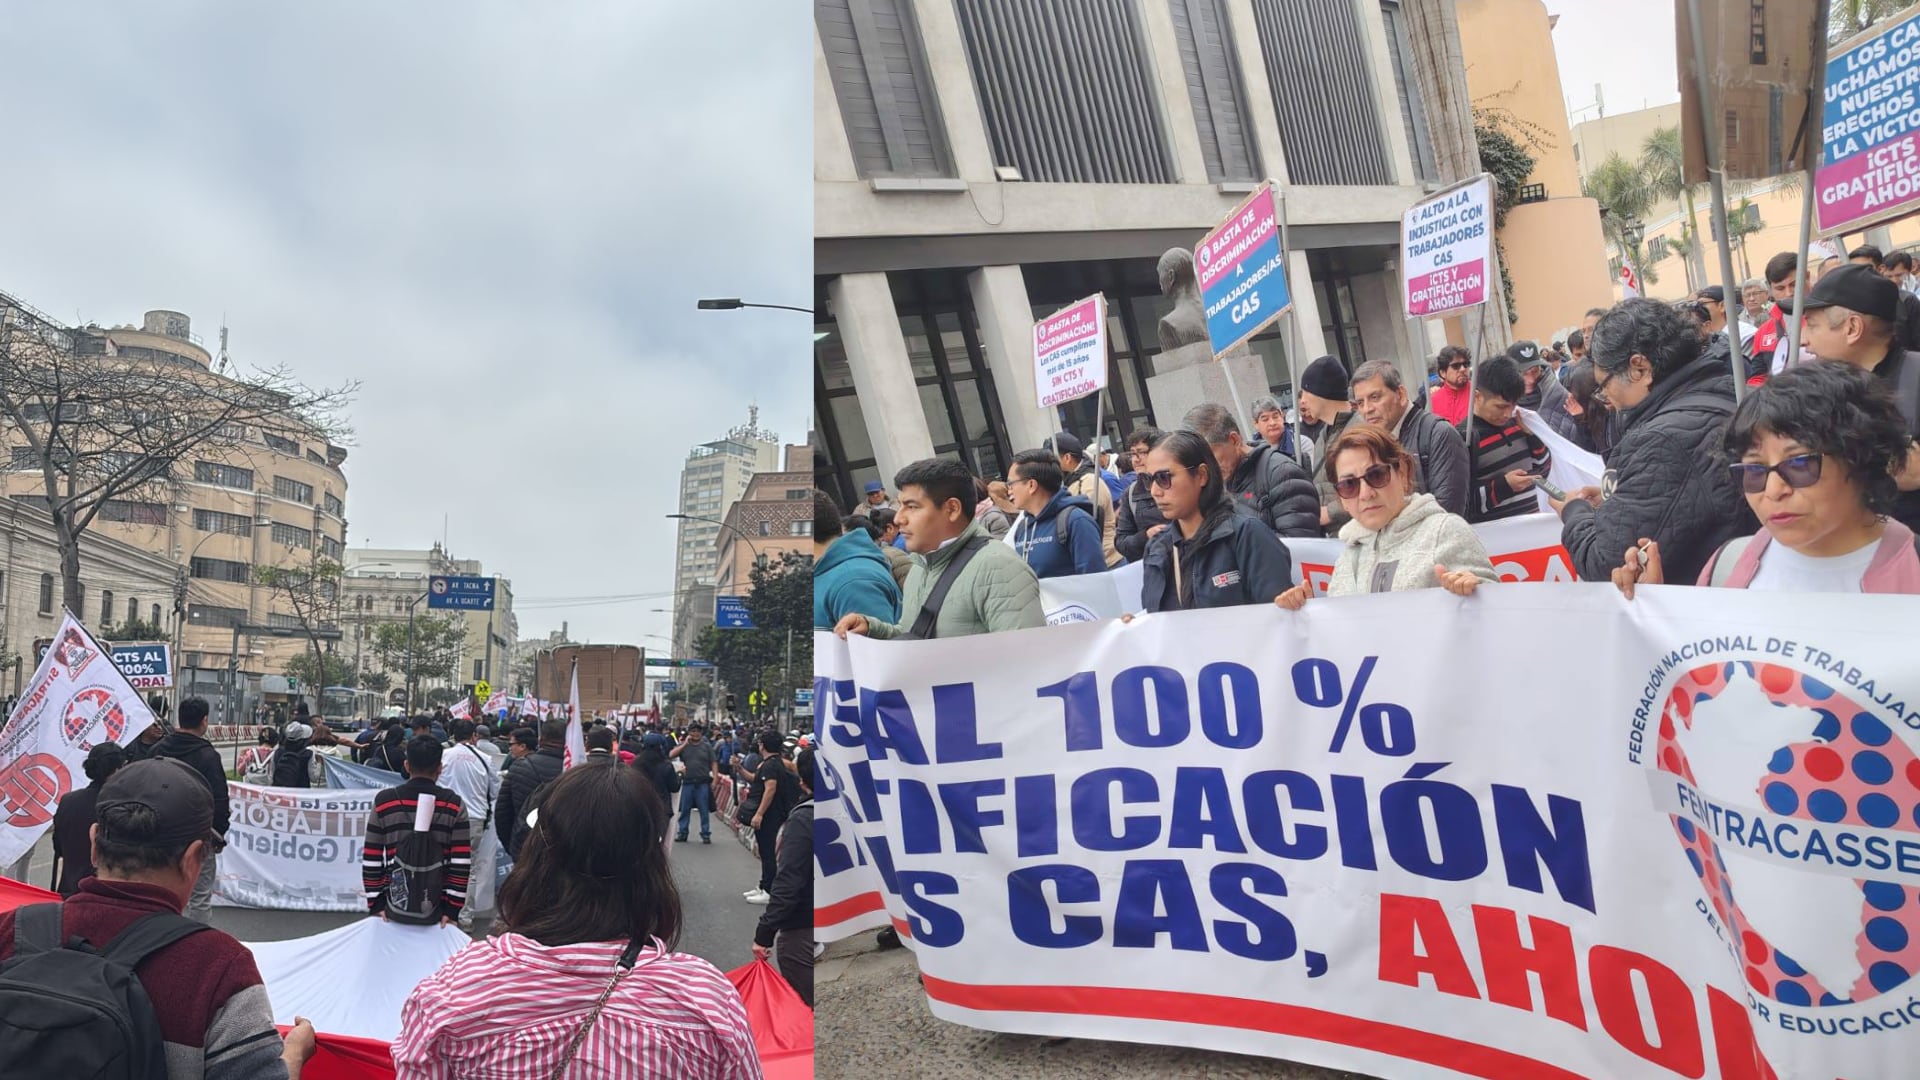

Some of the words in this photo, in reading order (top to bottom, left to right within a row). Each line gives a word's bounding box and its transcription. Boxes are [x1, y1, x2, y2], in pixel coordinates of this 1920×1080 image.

[1847, 38, 1887, 72] LOS
[1891, 22, 1920, 48] CA
[1824, 40, 1920, 103] UCHAMOS
[1841, 66, 1920, 115] NUESTR
[1823, 90, 1916, 144] ERECHOS
[1833, 137, 1860, 159] LA
[1823, 155, 1920, 204] GRATIFIC
[1409, 215, 1458, 242] INJUSTICIA
[1461, 204, 1483, 223] CON
[1421, 201, 1445, 220] ALTO
[1446, 198, 1454, 209] A
[1456, 191, 1469, 206] LA
[1202, 214, 1274, 284] DISCRIMINACIÓN
[1212, 223, 1241, 255] BASTA
[1242, 209, 1255, 227] DE
[1408, 223, 1484, 258] TRABAJADORES
[1236, 263, 1244, 278] A
[1434, 250, 1453, 267] CAS
[1452, 267, 1459, 280] Y
[1206, 254, 1282, 320] TRABAJADORES/AS
[1412, 274, 1481, 304] GRATIFICACIÓN
[1428, 294, 1464, 312] AHORA!
[1071, 312, 1081, 324] DE
[1231, 291, 1261, 325] CAS
[1050, 350, 1060, 362] CAS
[1052, 376, 1062, 387] SIN
[1063, 370, 1077, 382] CTS
[1079, 367, 1084, 377] Y
[115, 652, 140, 663] CTS
[144, 652, 162, 661] AL
[131, 677, 165, 687] ORA!
[1629, 669, 1666, 764] FEDERACIÓN
[1662, 635, 1758, 675] NACIONAL
[1765, 637, 1797, 657] DE
[860, 682, 1003, 766] AL
[1037, 661, 1263, 752] 100
[1291, 656, 1416, 757] %
[1677, 783, 1920, 875] FENTRACASSE
[1007, 859, 1328, 978] CAS,
[1695, 898, 1724, 941] DEL
